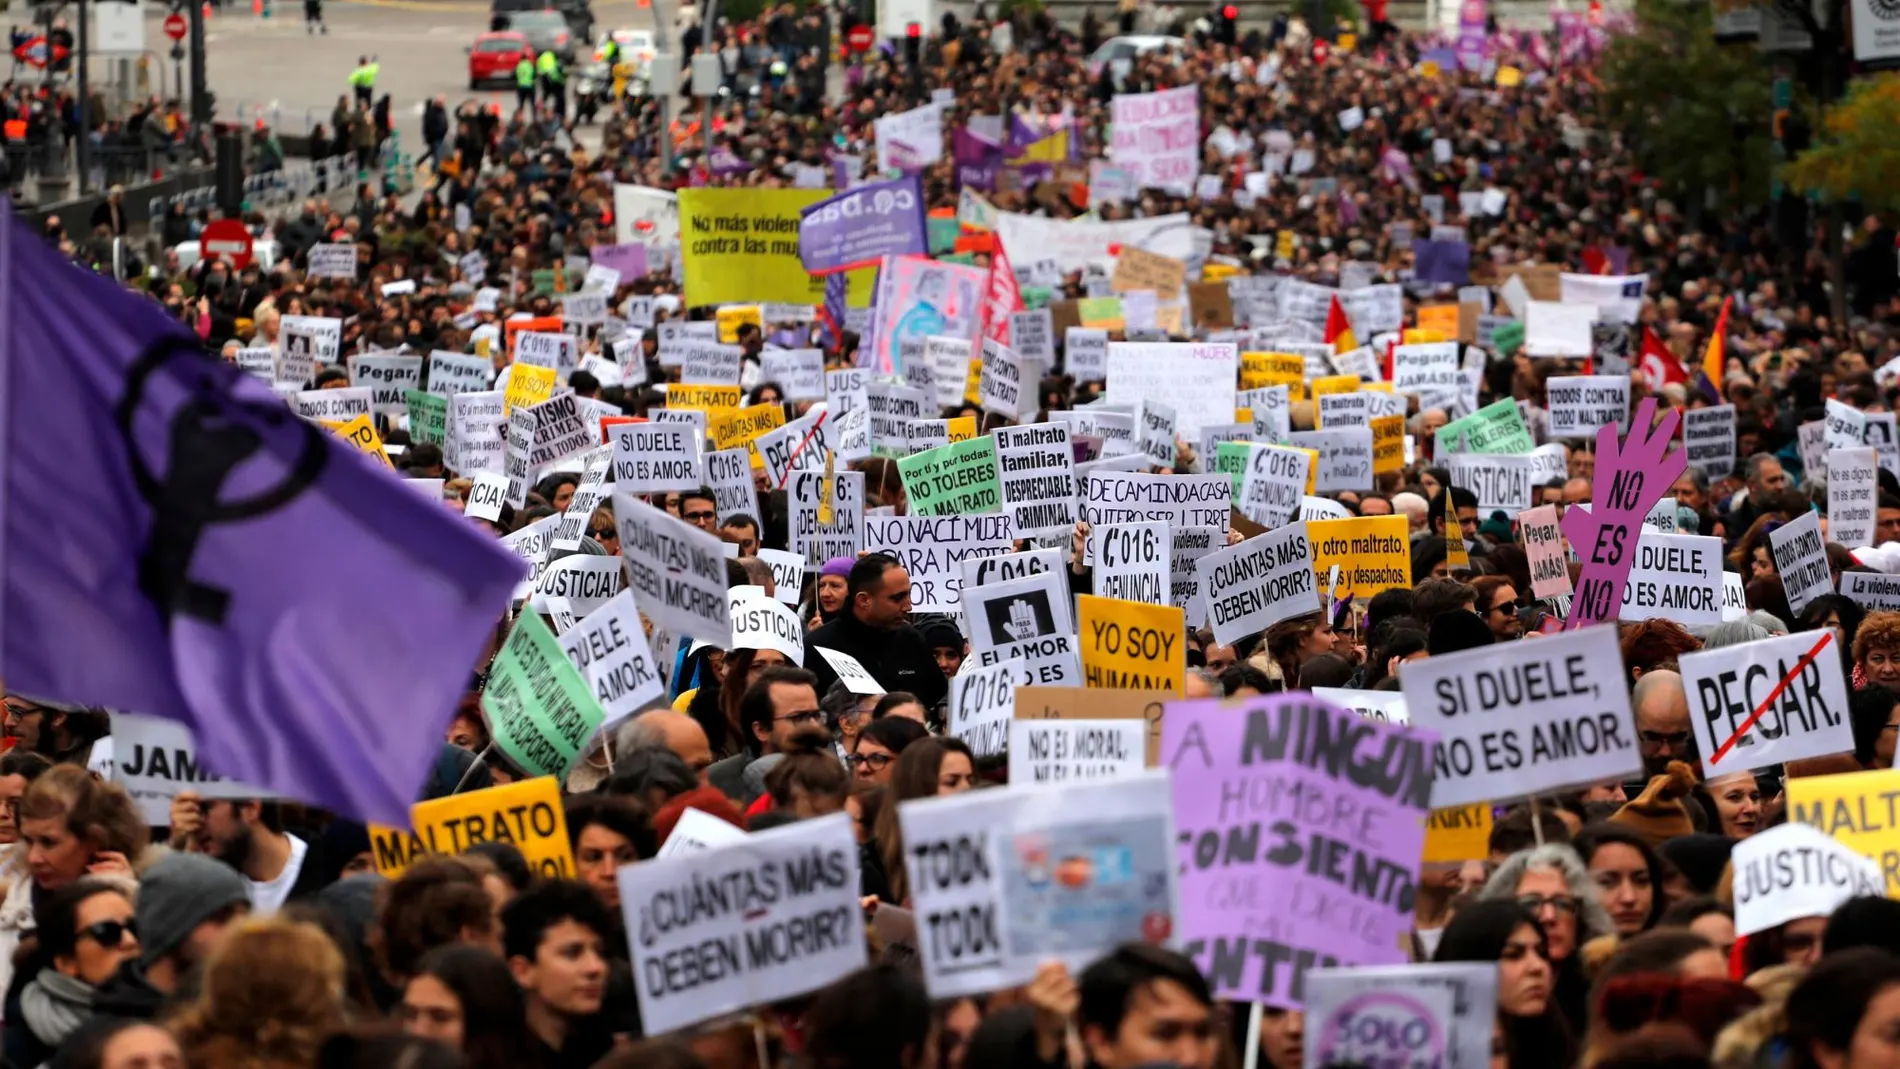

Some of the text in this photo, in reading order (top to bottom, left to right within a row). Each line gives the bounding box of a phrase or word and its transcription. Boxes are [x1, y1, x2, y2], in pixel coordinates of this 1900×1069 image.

[692, 214, 801, 232] No más violen
[692, 237, 768, 256] contra las
[359, 365, 416, 383] Pegar,
[433, 360, 485, 380] Pegar,
[995, 357, 1019, 384] CONTRA
[1396, 354, 1455, 368] Pegar,
[513, 374, 549, 394] YO SOY
[830, 373, 866, 392] JUS-
[1550, 387, 1624, 404] TODOS CONTRA
[332, 399, 369, 416] CONTRA
[669, 390, 738, 406] MALTRATO
[888, 398, 920, 418] CONTRA
[534, 415, 585, 446] CRIMEN
[717, 413, 753, 446] ¿CUÁNTAS
[754, 412, 773, 432] MÁS
[908, 422, 945, 438] El maltrato
[1079, 421, 1092, 434] Del
[1142, 407, 1172, 435] Pegar,
[1322, 414, 1364, 429] familiar,
[1552, 408, 1625, 427] TODO MALTRATO
[555, 431, 590, 455] TODOS
[620, 432, 686, 455] SI DUELE,
[998, 427, 1066, 448] El maltrato
[1468, 419, 1522, 450] TOLERES
[718, 455, 744, 480] 016:
[765, 424, 839, 485] PEGAR.
[905, 448, 992, 481] Por y por todas:
[1001, 450, 1069, 472] familiar,
[1269, 453, 1301, 479] 016:
[617, 460, 697, 480] NO ES AMOR.
[910, 463, 996, 501] NO TOLERES
[1005, 474, 1073, 503] DESPRECIABLE
[1090, 477, 1114, 502] DE
[1115, 479, 1188, 503] CAMINO
[1199, 481, 1232, 501] CASA
[1606, 469, 1644, 511] NO
[935, 489, 999, 517] MALTRATO.
[1015, 503, 1075, 530] CRIMINAL.
[866, 515, 1013, 547] NO NACÍ MUJER
[1173, 529, 1210, 550] violencia
[1323, 533, 1406, 557] otro maltrato,
[1524, 523, 1559, 547] Pegar,
[1591, 524, 1628, 566] ES
[1121, 528, 1160, 565] 016:
[1775, 527, 1822, 572] TODOS CONTRA
[691, 549, 721, 585] MÁS
[1001, 556, 1049, 581] 016:
[1171, 557, 1179, 573] el
[1209, 534, 1308, 598] ¿CUÁNTAS MÁS
[1533, 553, 1566, 583] JAMÁS!
[1642, 546, 1707, 578] DUELE,
[535, 568, 618, 599] JUSTICIA!
[1346, 564, 1406, 589] y despachos.
[1783, 557, 1829, 600] TODO MALTRATO
[1852, 576, 1865, 593] La
[665, 577, 725, 624] MORIR?
[1213, 569, 1312, 627] DEBEN MORIR?
[1578, 578, 1613, 621] NO
[1637, 582, 1657, 607] ES
[1661, 584, 1718, 612] AMOR.
[1010, 637, 1070, 660] AMOR
[1092, 620, 1175, 662] YO SOY
[597, 655, 655, 703] AMOR.
[1040, 664, 1064, 684] ES
[1435, 675, 1469, 717] SI
[1475, 655, 1599, 710] DUELE,
[975, 668, 1014, 714] 016:
[1697, 654, 1841, 755] PEGAR.
[1028, 730, 1049, 761] NO
[1054, 730, 1068, 761] ES
[1170, 719, 1213, 769] A
[1433, 712, 1631, 782] NO ES AMOR.
[1218, 776, 1391, 850] HOMBRE
[640, 845, 848, 948] ¿CUÁNTAS MÁS
[645, 905, 853, 999] DEBEN MORIR?
